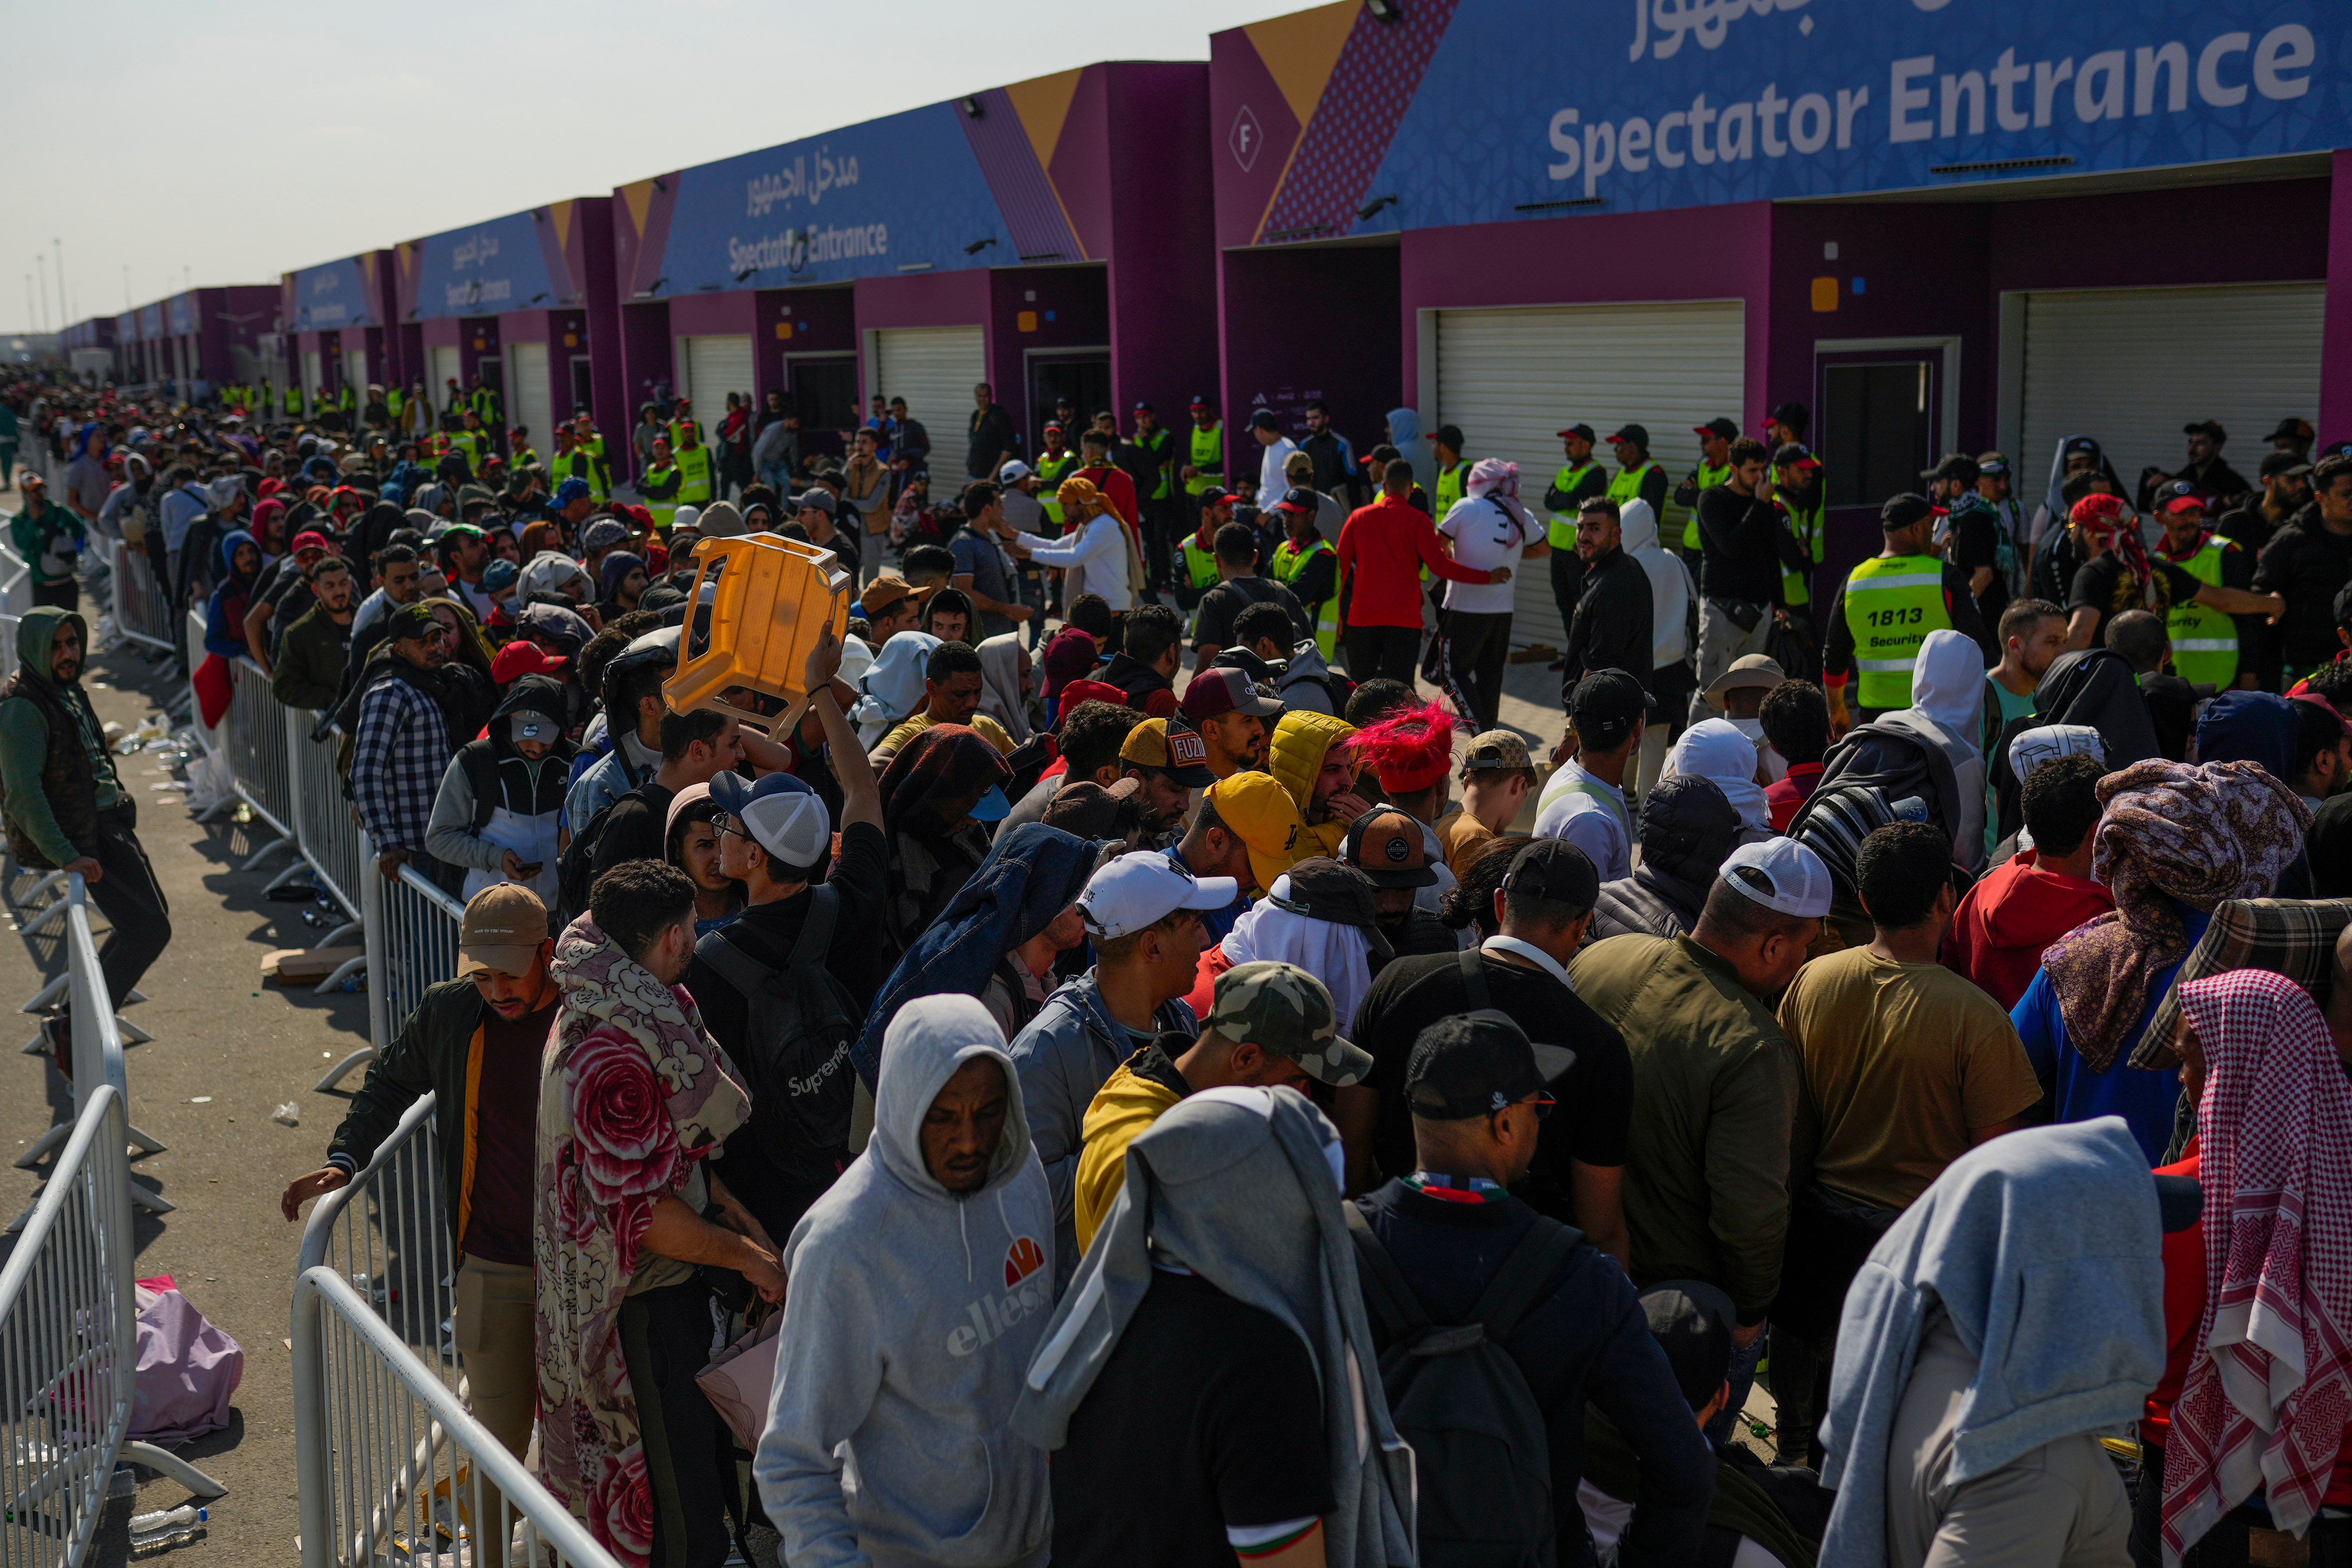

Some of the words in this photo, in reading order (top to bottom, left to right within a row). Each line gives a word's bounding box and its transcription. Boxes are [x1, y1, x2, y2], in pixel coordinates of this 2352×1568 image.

[1548, 83, 1868, 198] Spectator
[1890, 24, 2315, 143] Entrance
[1239, 123, 1252, 153] F
[747, 155, 806, 218] الجمهور
[807, 144, 859, 206] مدخل
[806, 223, 888, 263] Entrance
[1867, 607, 1923, 628] 1813
[1869, 632, 1926, 648] Security
[788, 1040, 849, 1097] Supreme
